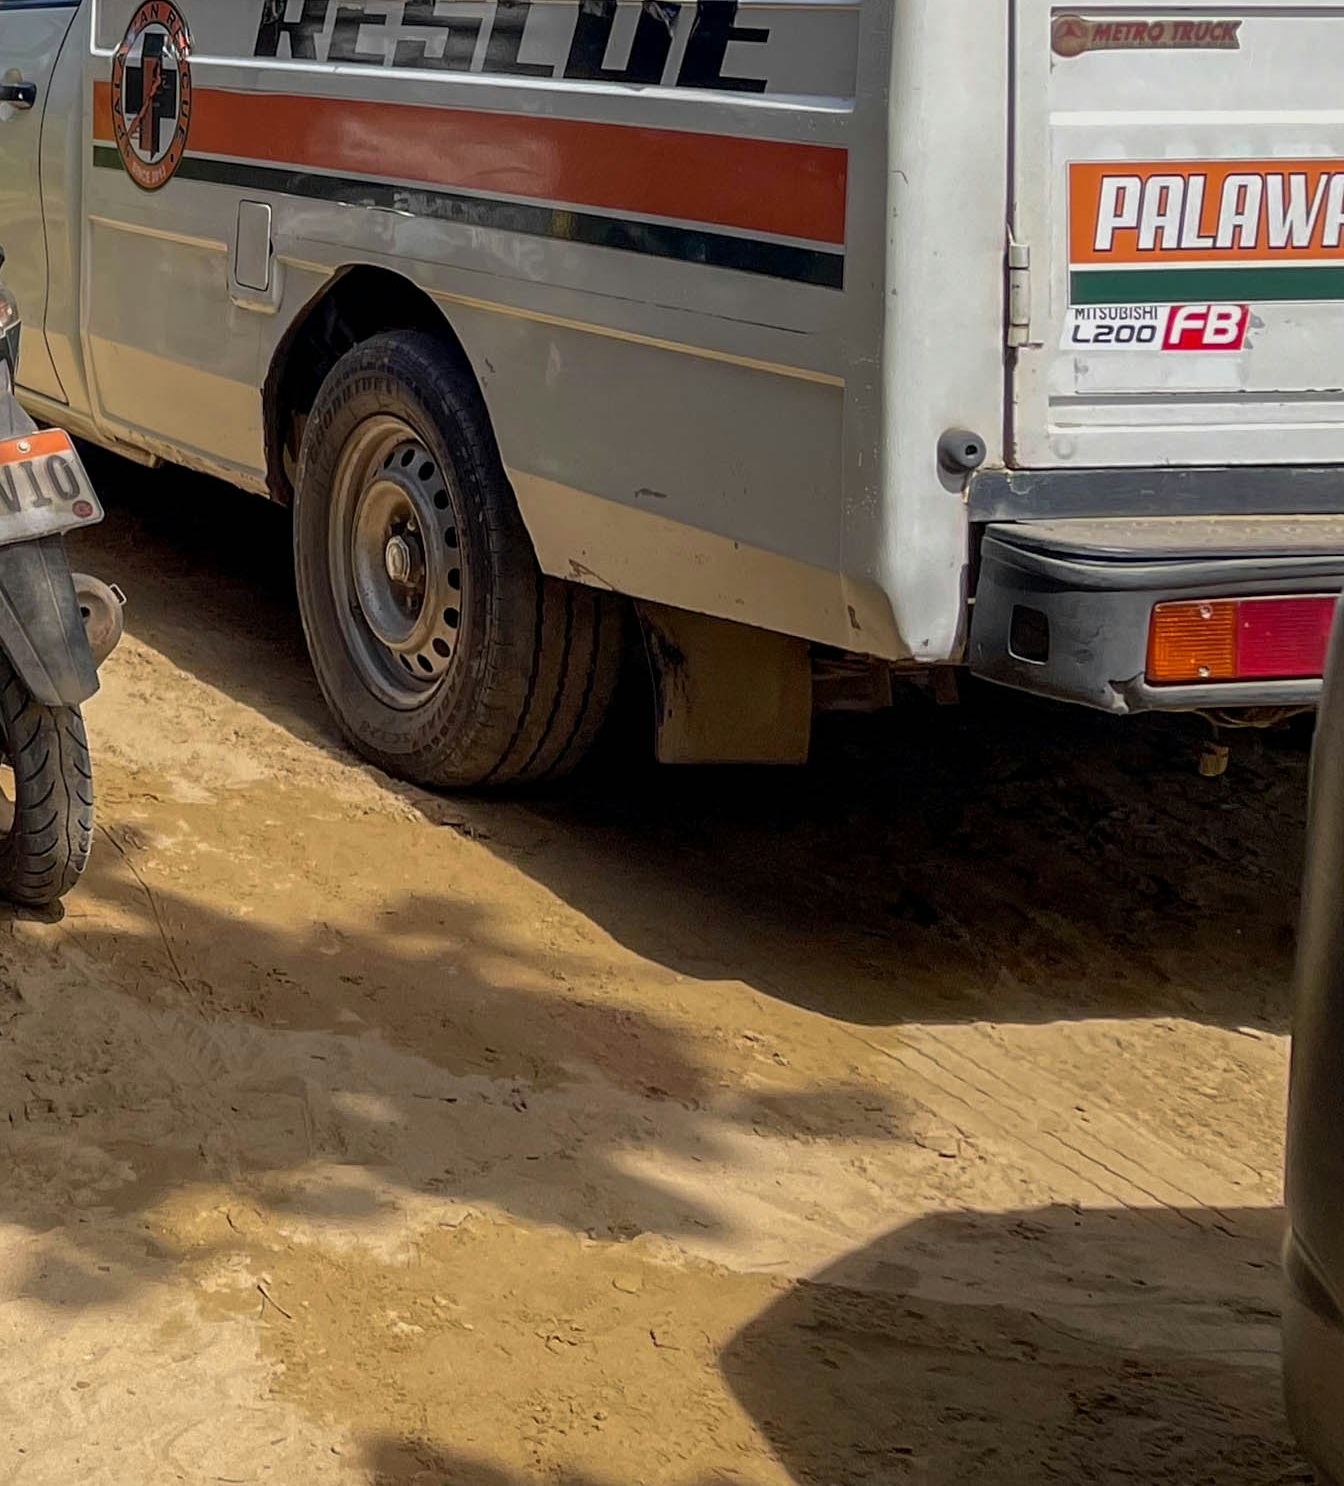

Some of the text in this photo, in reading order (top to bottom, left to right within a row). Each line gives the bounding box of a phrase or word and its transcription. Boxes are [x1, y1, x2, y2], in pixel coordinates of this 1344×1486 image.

[1092, 21, 1238, 42] METRO TRUCK
[1075, 306, 1158, 320] MITSUBISHI
[1072, 305, 1243, 345] L200 FB
